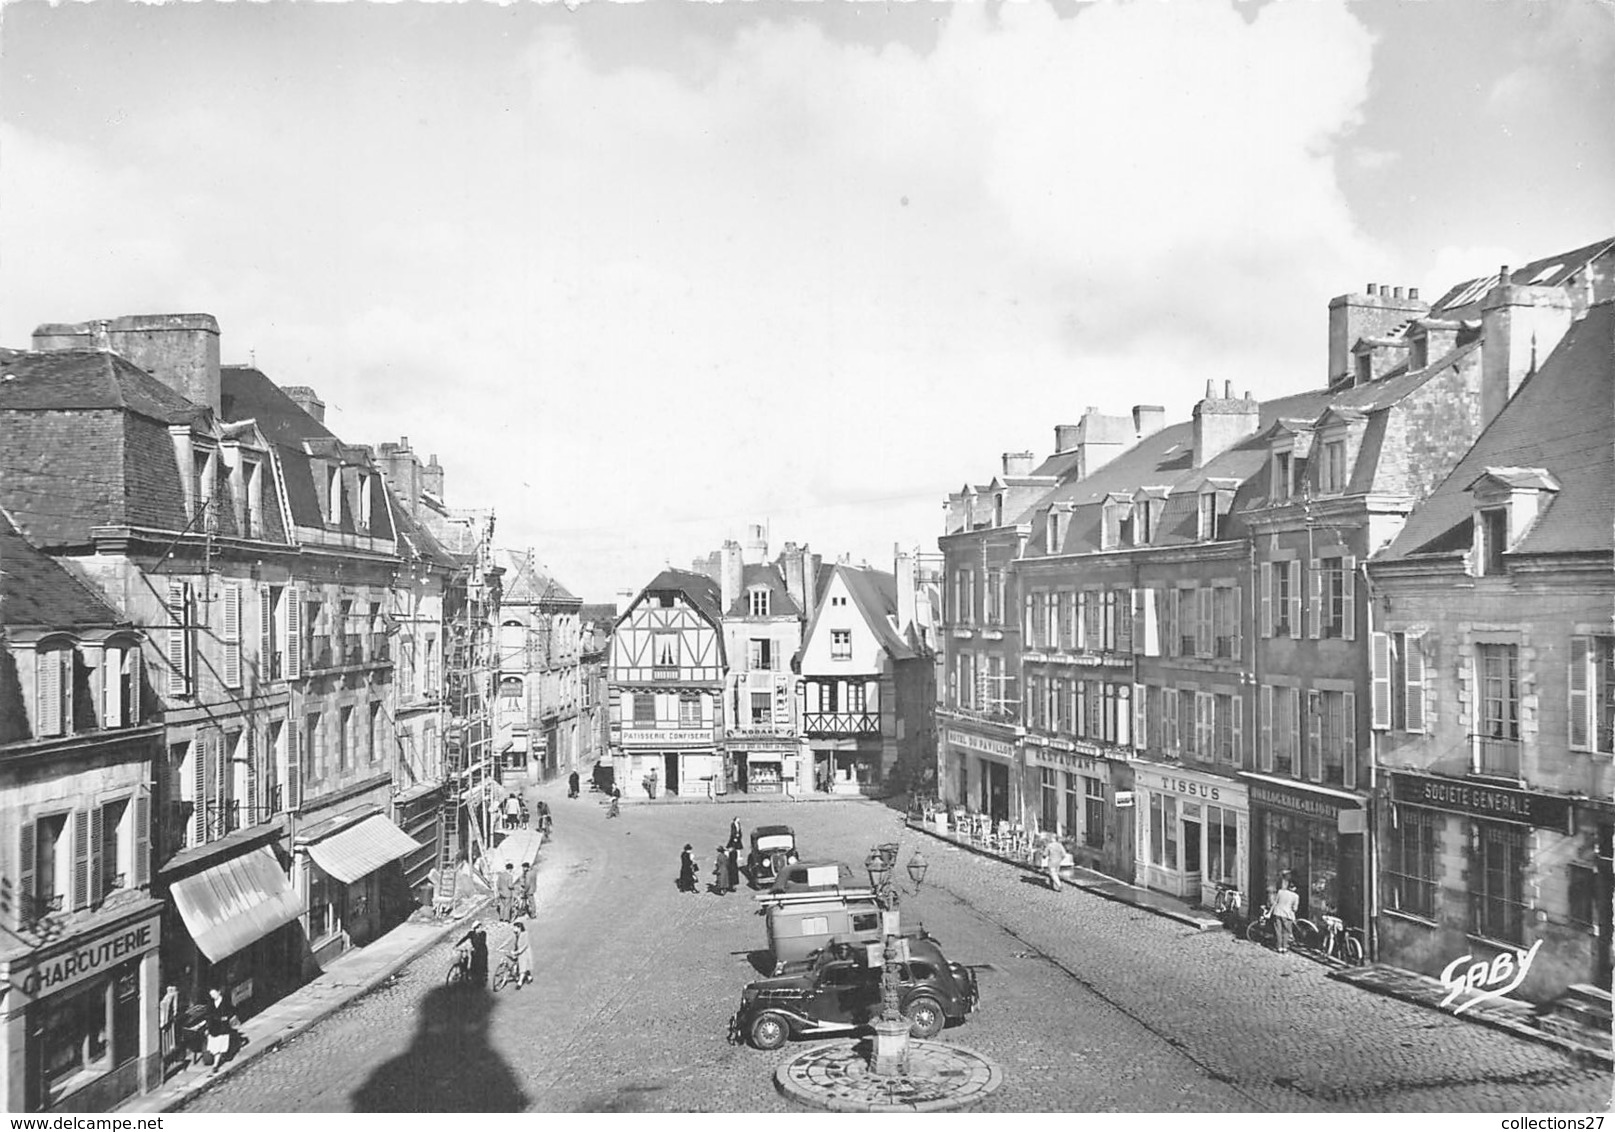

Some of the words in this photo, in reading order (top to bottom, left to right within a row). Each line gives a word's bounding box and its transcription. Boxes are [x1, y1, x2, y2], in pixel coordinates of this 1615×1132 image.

[623, 732, 665, 740] PATISSERIE
[669, 732, 711, 740] CONFISERIE
[979, 739, 1013, 757] PAVILLON
[1035, 749, 1097, 772] RESTAURANT
[1161, 777, 1221, 801] TISSUS
[22, 924, 152, 995] CHARCUTERIE
